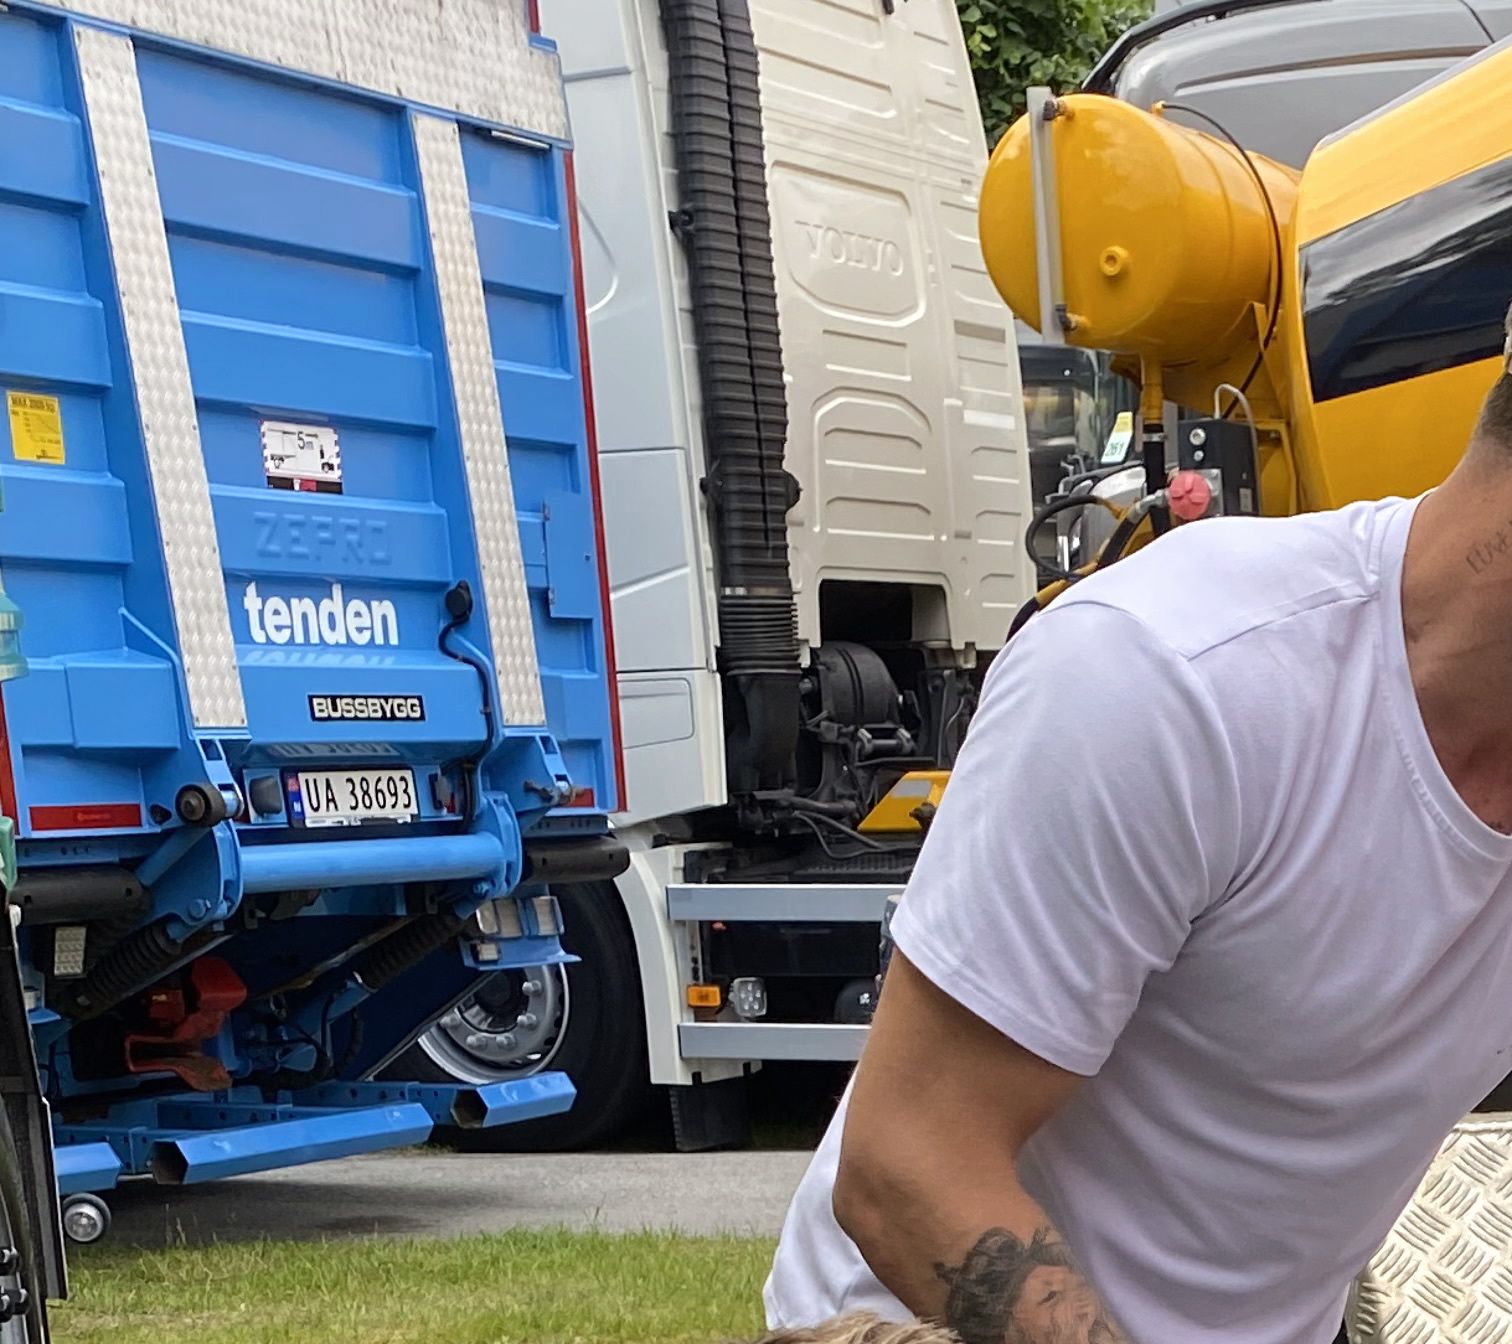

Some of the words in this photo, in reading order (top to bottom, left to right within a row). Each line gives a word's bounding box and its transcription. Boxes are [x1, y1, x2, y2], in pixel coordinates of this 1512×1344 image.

[243, 581, 399, 645] tenden
[312, 697, 421, 719] BUSSBYGG
[305, 777, 339, 813] UA
[346, 775, 411, 811] 38693
